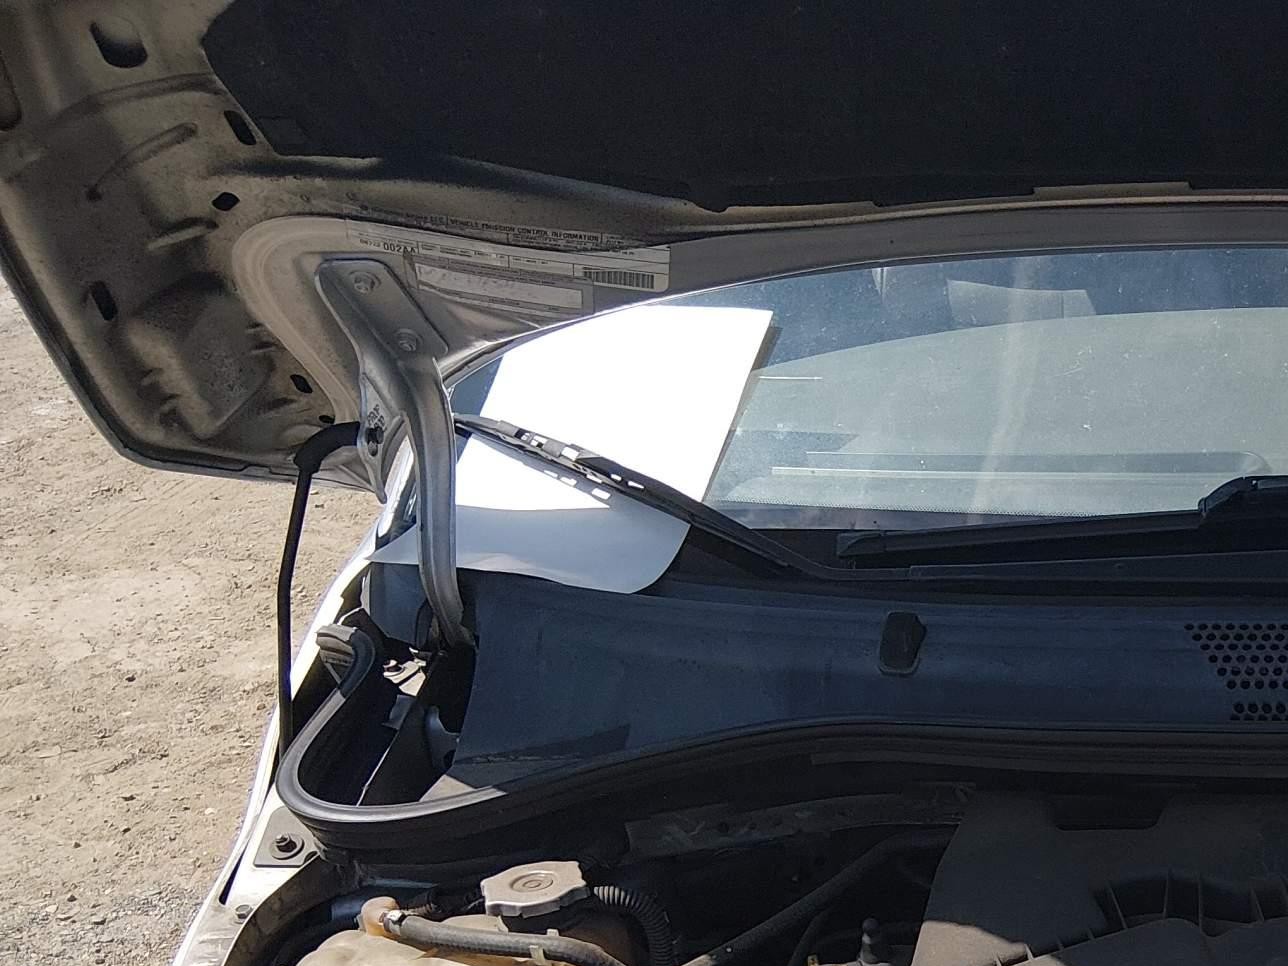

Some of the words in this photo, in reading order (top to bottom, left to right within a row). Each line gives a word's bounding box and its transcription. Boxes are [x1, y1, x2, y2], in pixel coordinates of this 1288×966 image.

[449, 218, 480, 228] VEHICLE
[481, 222, 516, 233] EMISSION
[517, 226, 549, 237] CONTROL
[551, 230, 599, 242] INFORMATION
